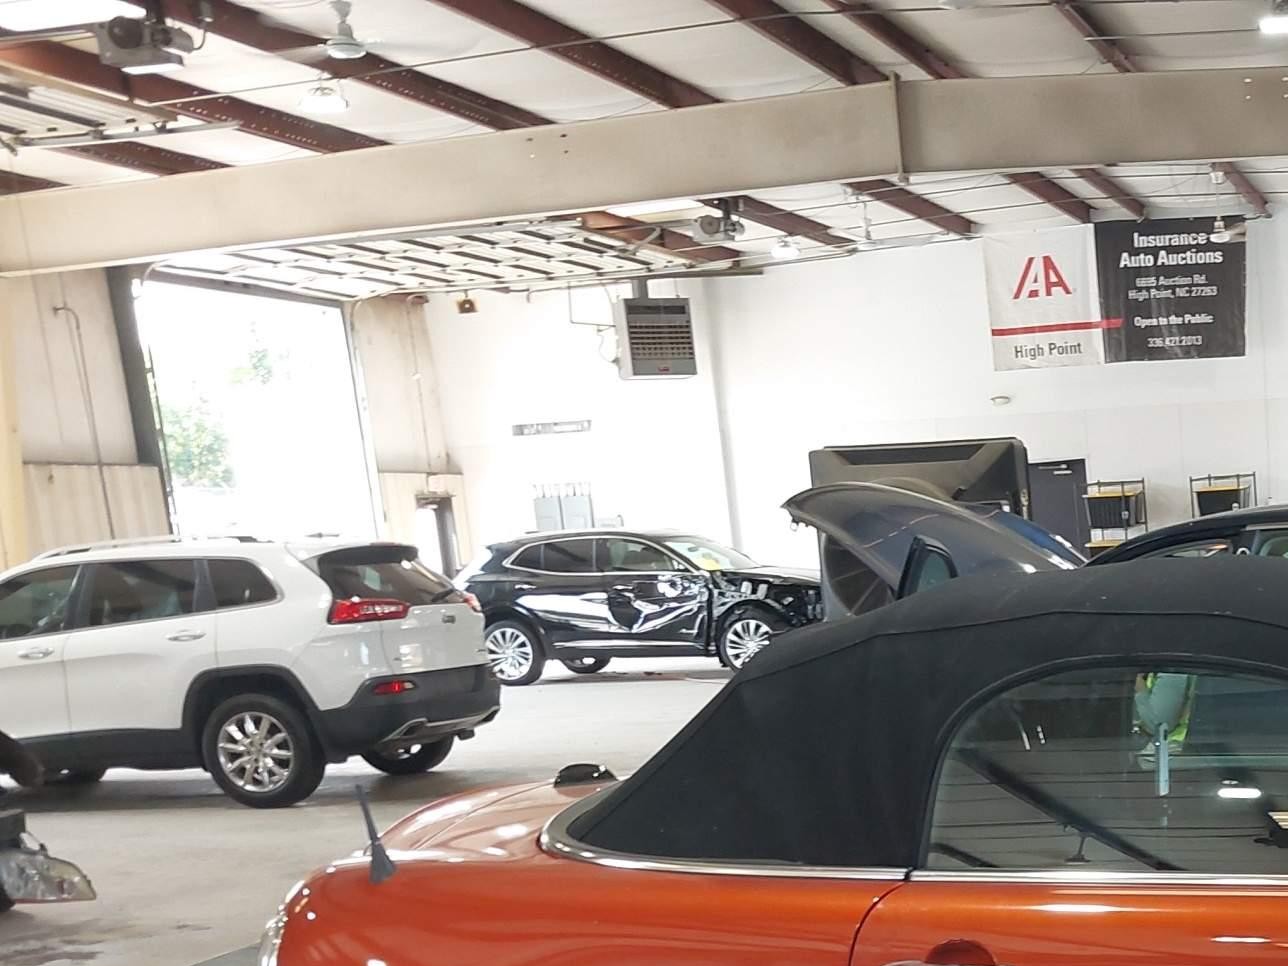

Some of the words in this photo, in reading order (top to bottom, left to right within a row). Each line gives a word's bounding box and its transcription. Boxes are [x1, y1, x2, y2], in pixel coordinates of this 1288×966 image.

[1133, 232, 1208, 248] Insurance
[1119, 252, 1154, 268] Auto
[1156, 249, 1223, 266] Auctions
[1127, 289, 1149, 302] High
[1175, 287, 1190, 297] NC
[1133, 316, 1158, 329] Open
[1158, 317, 1168, 325] to
[1168, 315, 1183, 325] the
[1184, 313, 1214, 324] Public
[1014, 344, 1045, 361] High
[1048, 341, 1083, 355] Point
